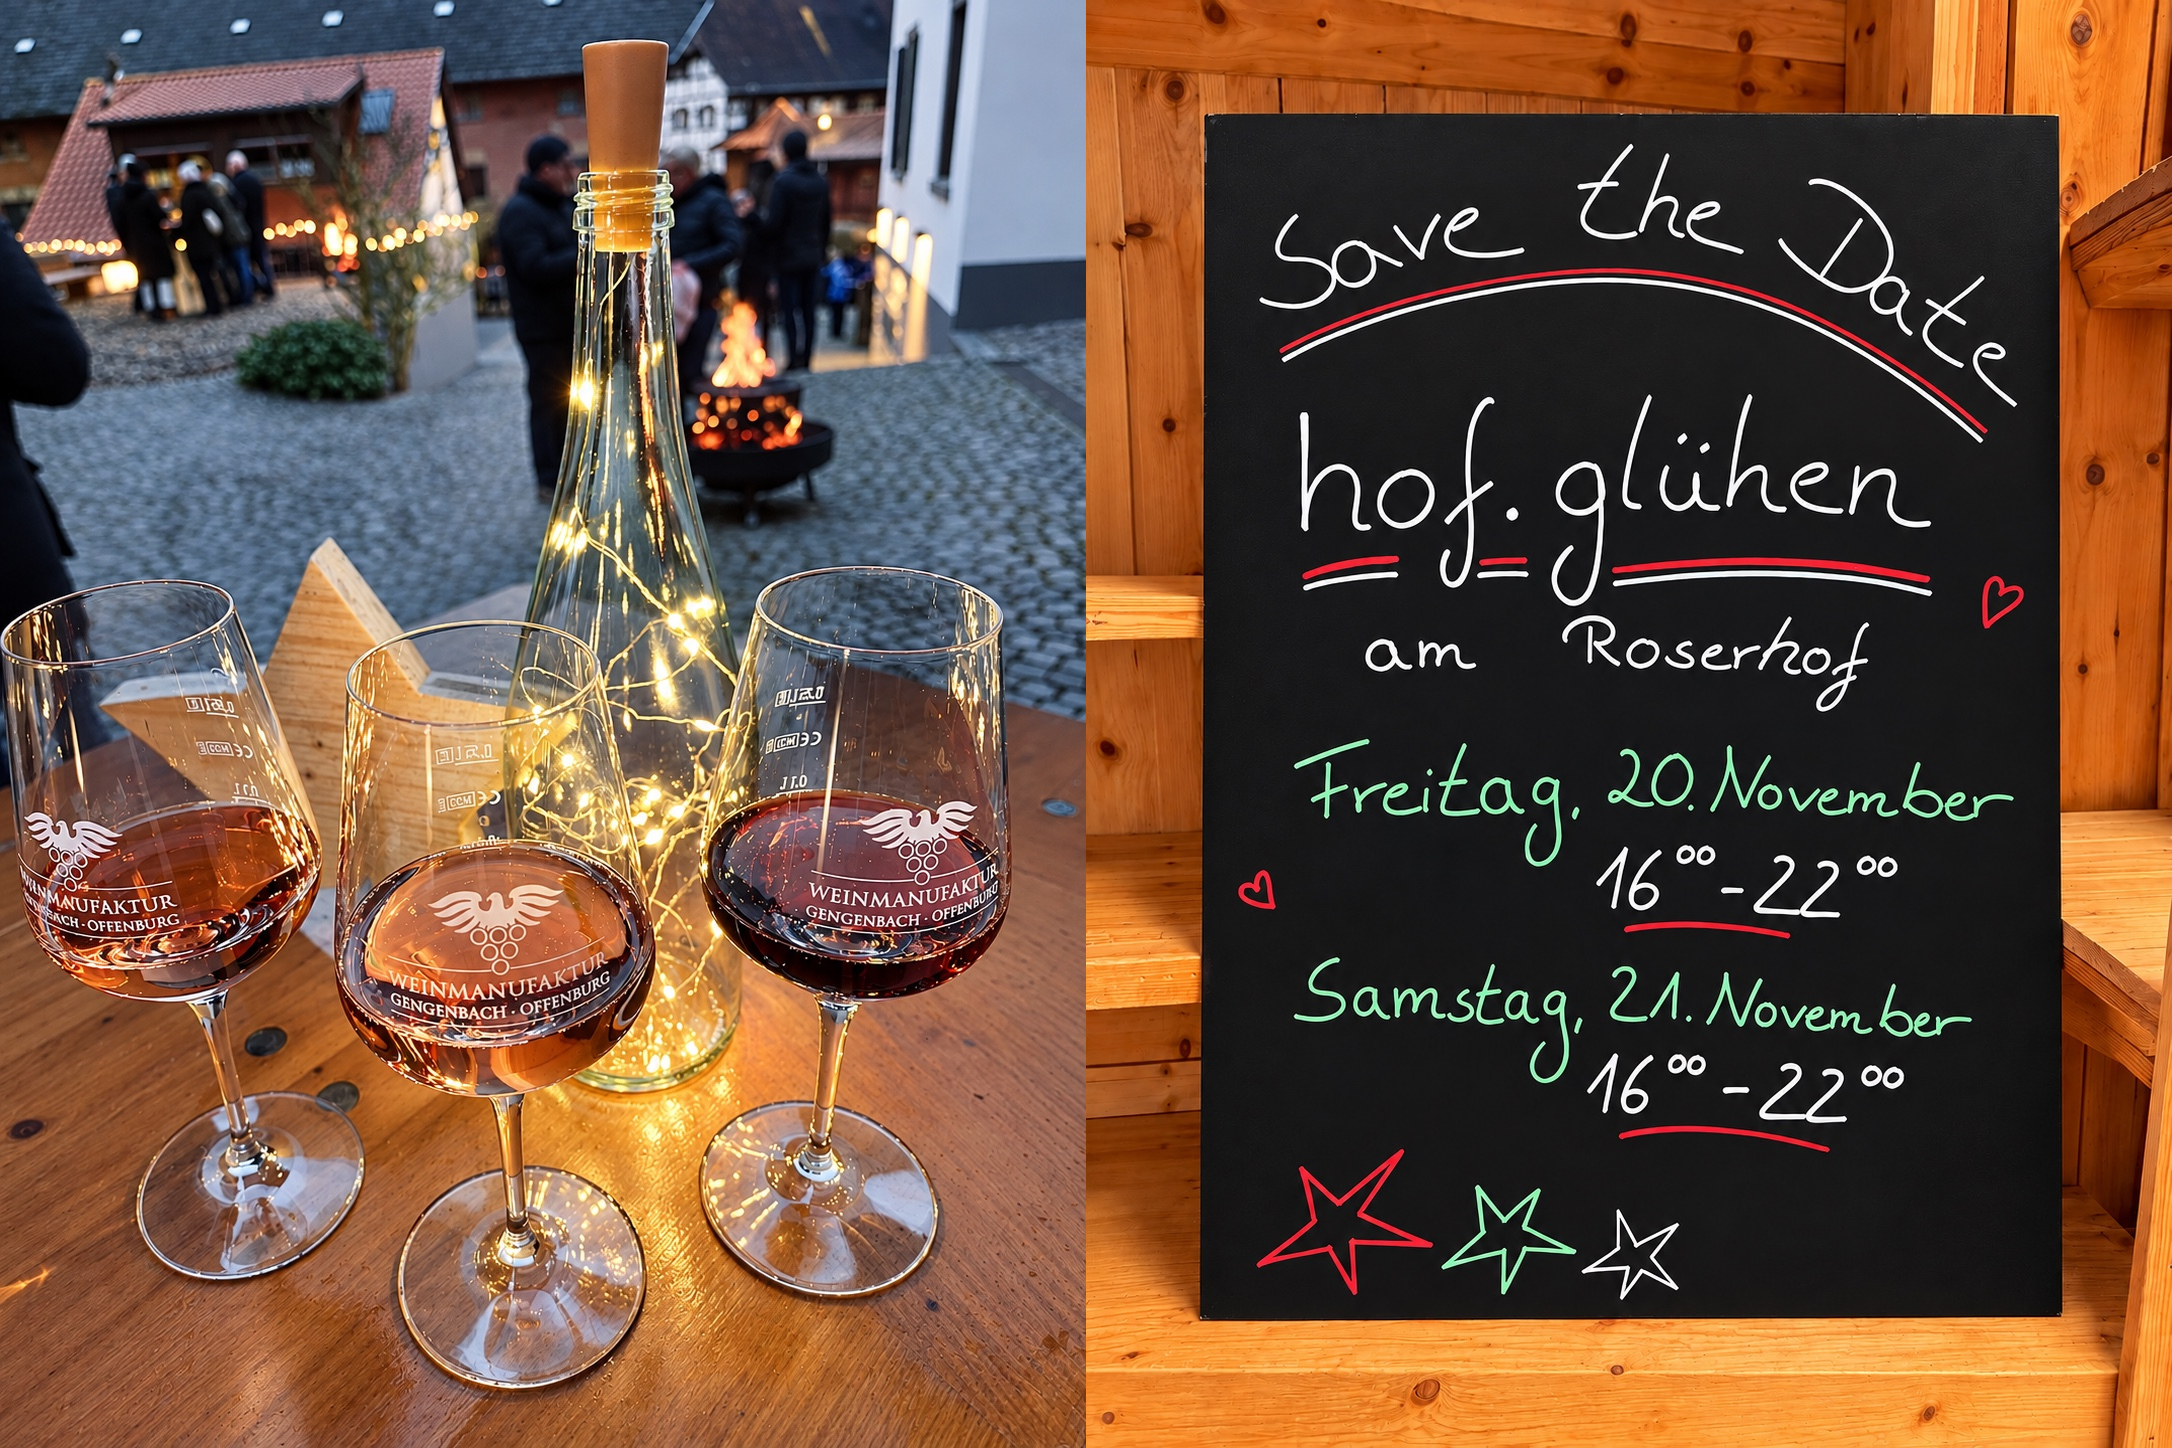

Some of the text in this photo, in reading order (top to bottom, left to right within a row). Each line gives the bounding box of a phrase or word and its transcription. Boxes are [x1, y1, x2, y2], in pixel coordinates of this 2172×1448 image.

[1259, 144, 2017, 407] Save the Date
[1365, 615, 1869, 712] am Roserhof
[1294, 739, 1580, 867] Freitag,
[808, 862, 999, 908] WEINMANUFAKTUR
[87, 913, 180, 933] OFFENBURG
[805, 905, 921, 928] GENGENBACH
[388, 951, 609, 1001] WEINMANUFAKTUR
[390, 971, 611, 1021] GENGENBACH OFFENBURG
[1294, 957, 1582, 1083] Samstag,
